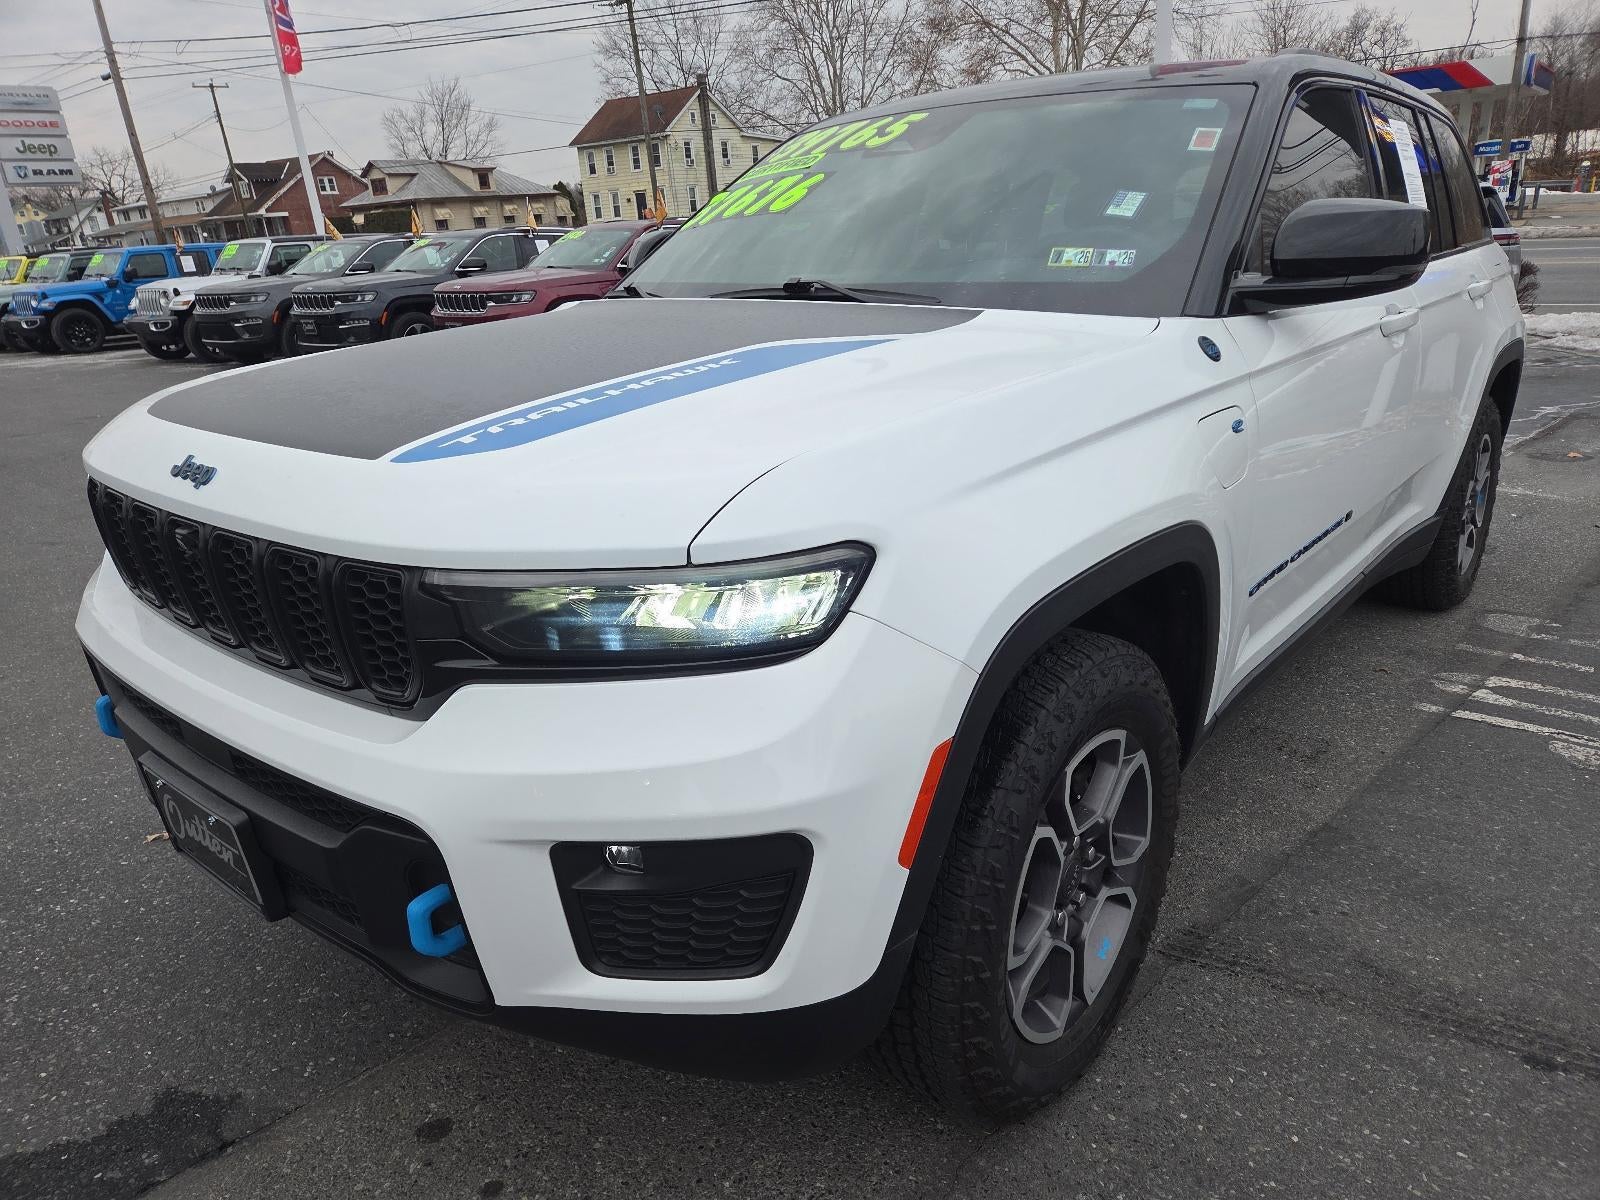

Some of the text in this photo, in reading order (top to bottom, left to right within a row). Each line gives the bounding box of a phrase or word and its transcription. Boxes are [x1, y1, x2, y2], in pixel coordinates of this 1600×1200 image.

[15, 139, 58, 157] Jeep
[31, 168, 74, 176] RAM
[1077, 250, 1091, 264] 26
[1121, 251, 1135, 265] 26
[437, 358, 740, 448] TRAILHAWK
[169, 454, 218, 490] Jeep
